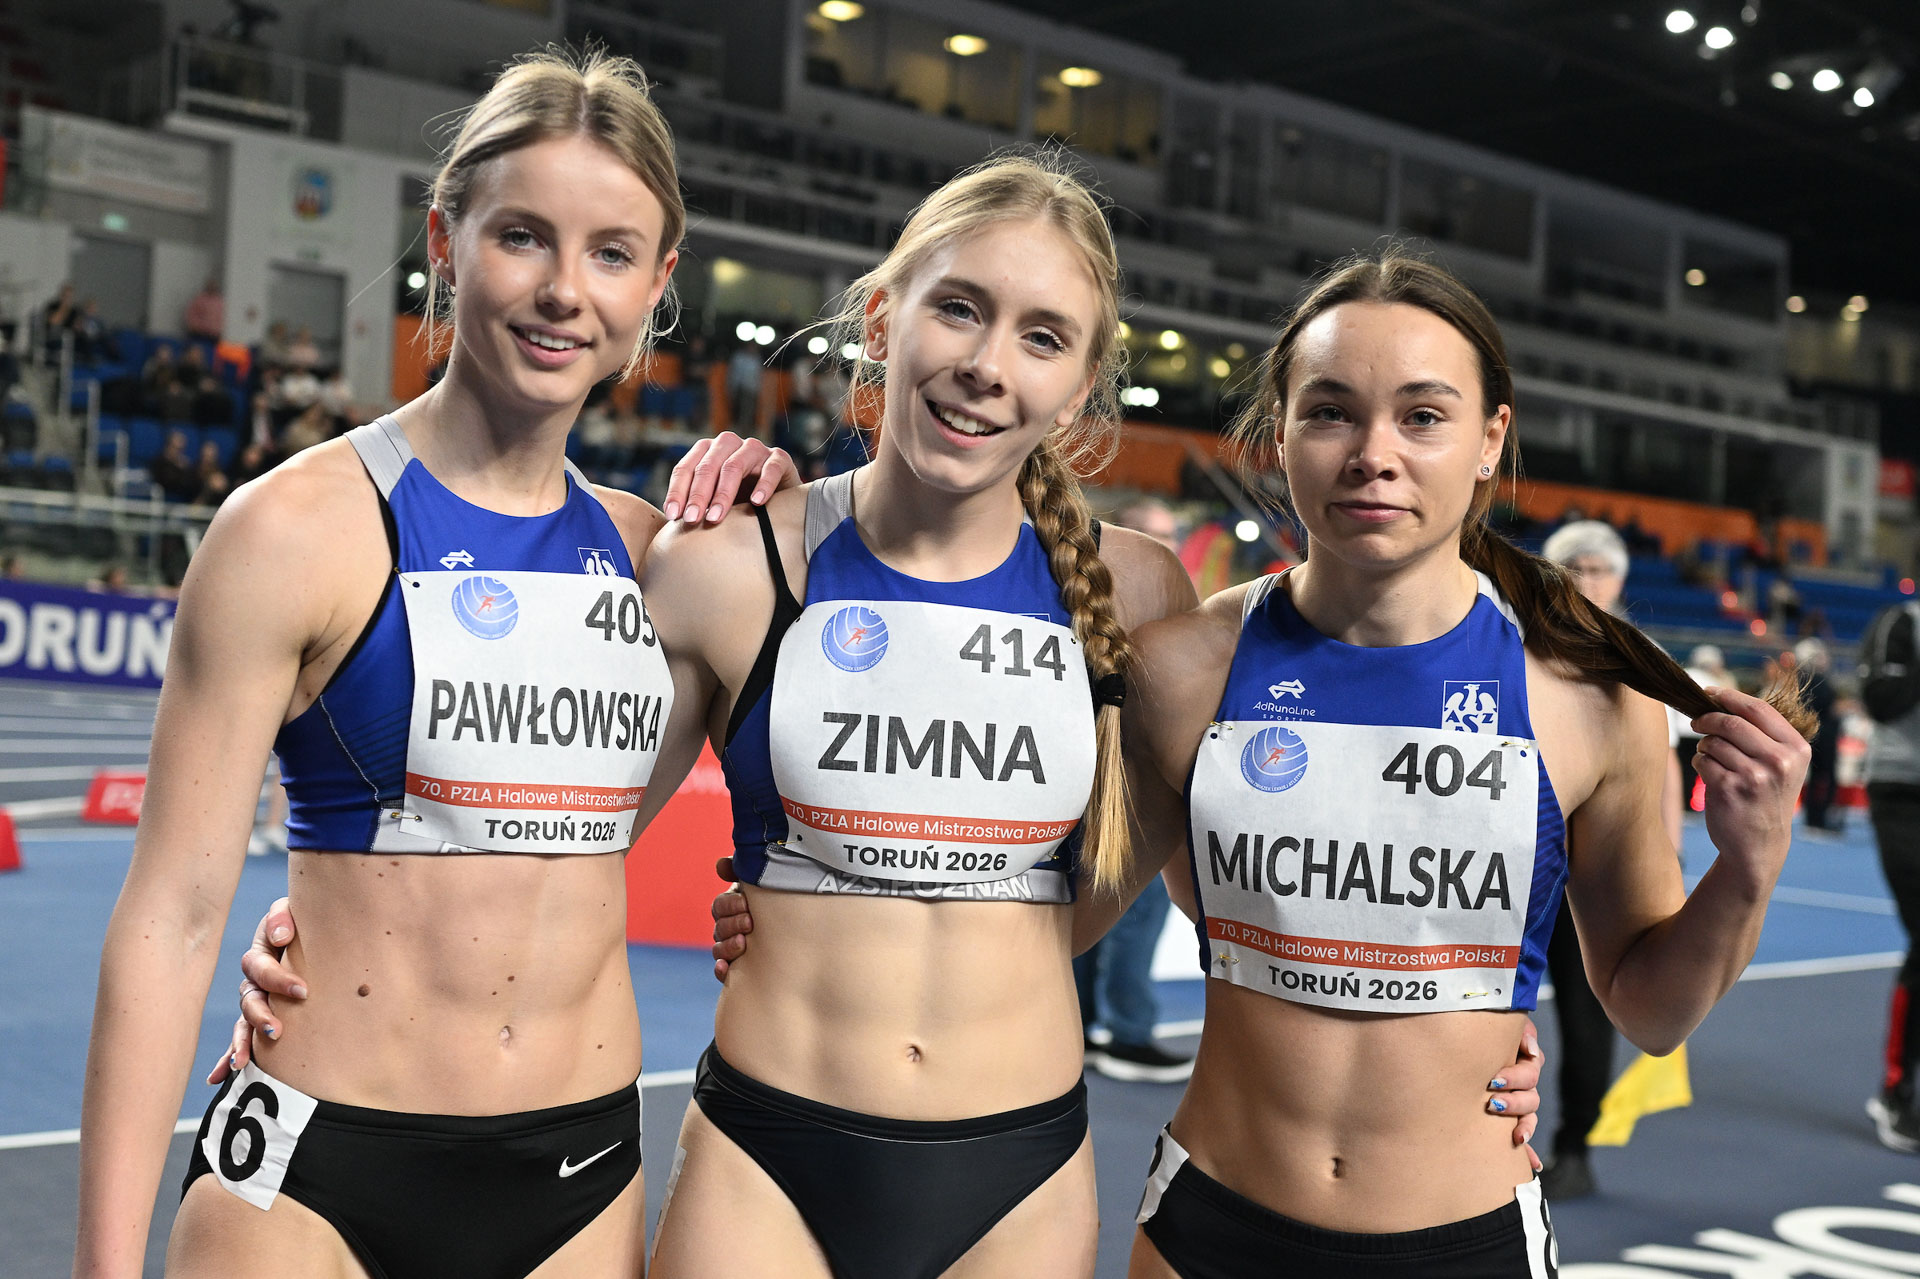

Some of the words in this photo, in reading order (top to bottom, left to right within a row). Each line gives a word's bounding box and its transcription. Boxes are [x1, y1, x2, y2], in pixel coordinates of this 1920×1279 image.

[585, 590, 656, 647] 405
[959, 624, 1067, 681] 414
[428, 679, 662, 752] PAWŁOWSKA
[1253, 701, 1316, 716] AdRunaLine
[818, 711, 1047, 785] ZIMNA
[1382, 742, 1507, 800] 404
[420, 780, 445, 798] 70.
[450, 786, 493, 803] PZLA
[497, 788, 557, 804] Halowe
[561, 790, 626, 807] Mistrzostwa
[485, 815, 576, 841] TORUŃ
[581, 821, 616, 841] 2026
[788, 803, 808, 822] 70.
[812, 812, 848, 829] PZLA
[853, 815, 919, 834] Halowe
[924, 820, 1024, 840] Mistrzostwa
[1028, 823, 1070, 840] Polski
[843, 845, 939, 871] TORUŃ
[946, 852, 1008, 871] 2026
[1207, 830, 1511, 911] MICHALSKA
[816, 872, 880, 896] AZS
[1218, 922, 1240, 938] 70.
[1242, 928, 1272, 950] PZLA
[1275, 939, 1338, 959] Halowe
[1343, 946, 1450, 966] Mistrzostwa
[1454, 948, 1507, 964] Polski
[1268, 965, 1360, 998] TORUŃ
[1368, 979, 1438, 1001] 2026
[219, 1081, 279, 1181] 6
